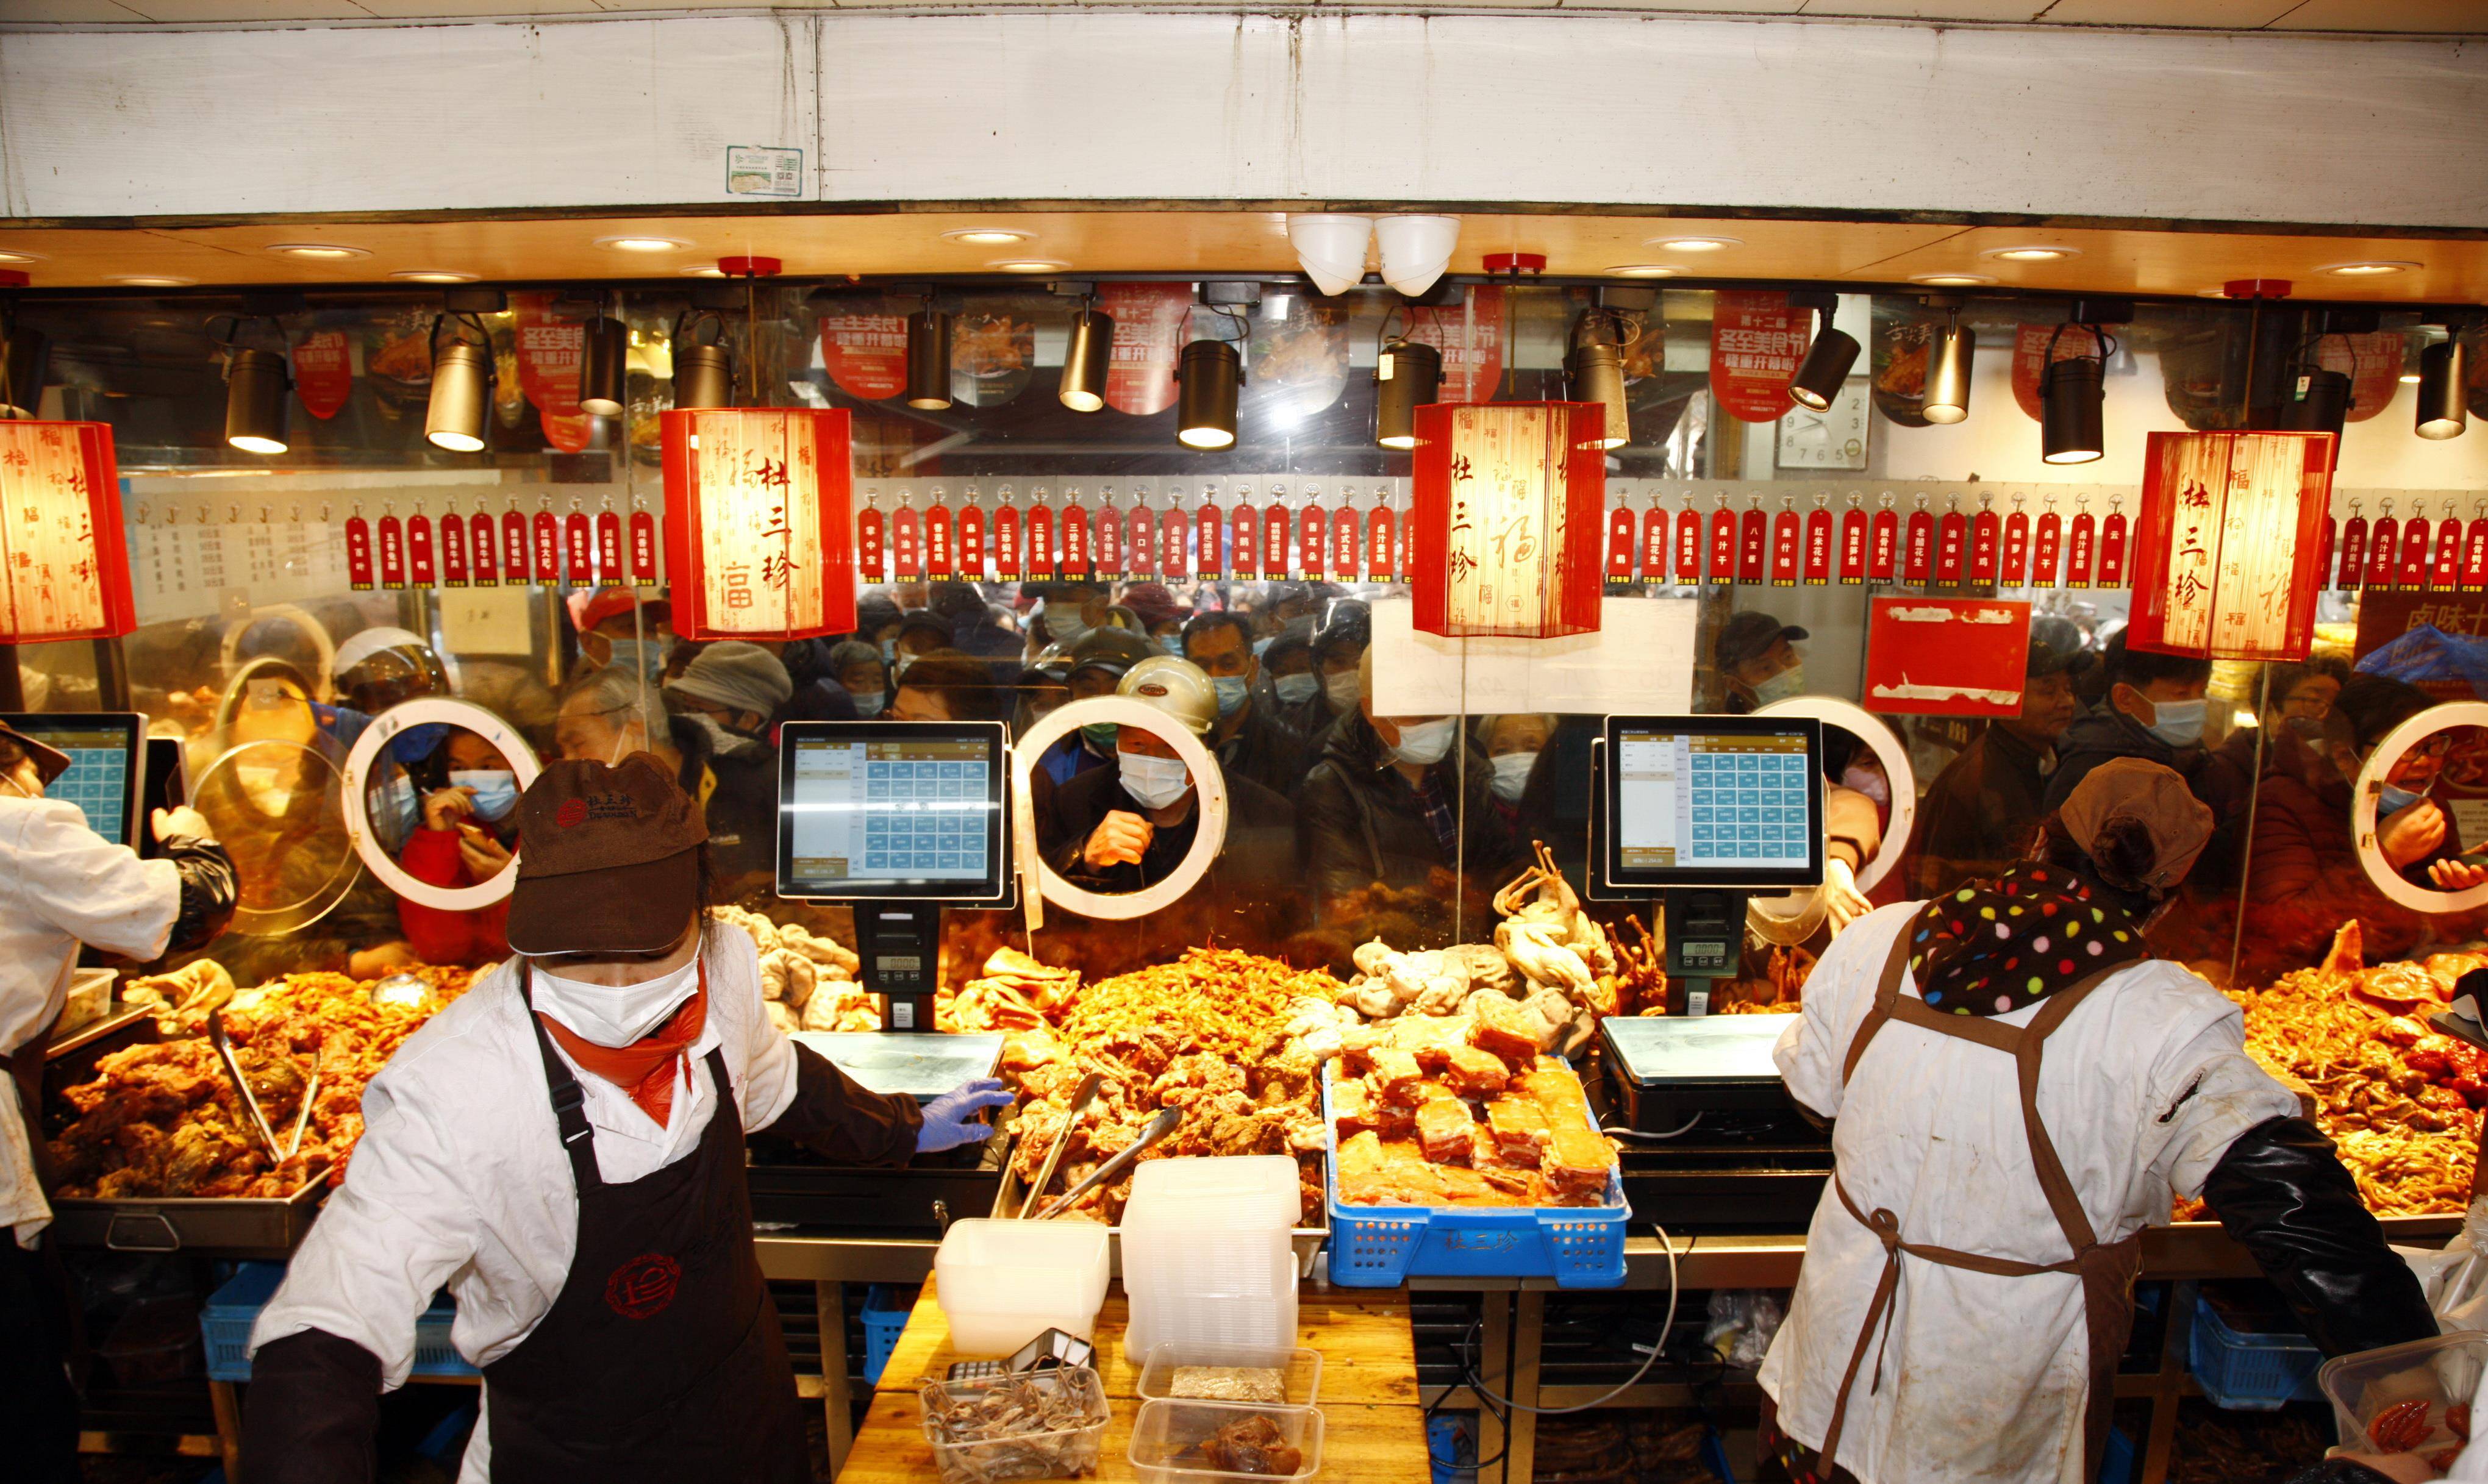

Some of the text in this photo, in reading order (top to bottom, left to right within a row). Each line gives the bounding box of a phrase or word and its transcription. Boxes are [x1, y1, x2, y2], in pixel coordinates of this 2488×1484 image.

[1114, 321, 1183, 346] 至美食节
[1740, 315, 1787, 329] 第十二届
[1886, 321, 1932, 345] 舌尖美
[1718, 329, 1806, 357] 冬至美食节
[1725, 353, 1795, 371] 隆重开幕啦
[1787, 416, 1794, 427] 9
[1852, 398, 1859, 409] 2
[1786, 436, 1794, 447] 8
[1852, 418, 1859, 429] 3
[1800, 448, 1807, 458] 7
[1817, 450, 1825, 460] 6
[1836, 449, 1843, 460] 5
[756, 457, 801, 588] 杜三珍
[1451, 452, 1478, 583] 杜三珍
[1035, 523, 1045, 562] 三珍酱肉
[1069, 523, 1079, 562] 三珍头肉
[1104, 523, 1114, 562] 白水猪肚
[1137, 523, 1146, 562] 酱口条
[1170, 525, 1181, 565] 卤味鸡爪
[1307, 522, 1318, 562] 酱耳朵
[1340, 524, 1351, 564] 苏式叉烧
[1376, 524, 1386, 563] 卤汁素鸡
[1683, 527, 1693, 566] 麻辣鸡爪
[1718, 526, 1728, 565] 卤汁干
[1780, 527, 1792, 568] 素什锦
[1812, 527, 1824, 566] 红米花生
[1878, 527, 1889, 566] 脱骨鸭爪
[1914, 527, 1925, 566] 老醋花生
[1978, 528, 1990, 566] 口水鸡
[2041, 529, 2053, 569] 卤汁干
[2075, 530, 2087, 569] 卤汁香菇
[2106, 530, 2119, 569] 云丝
[2175, 479, 2210, 605] 杜三珍
[1444, 1230, 1520, 1254] 杜三珍
